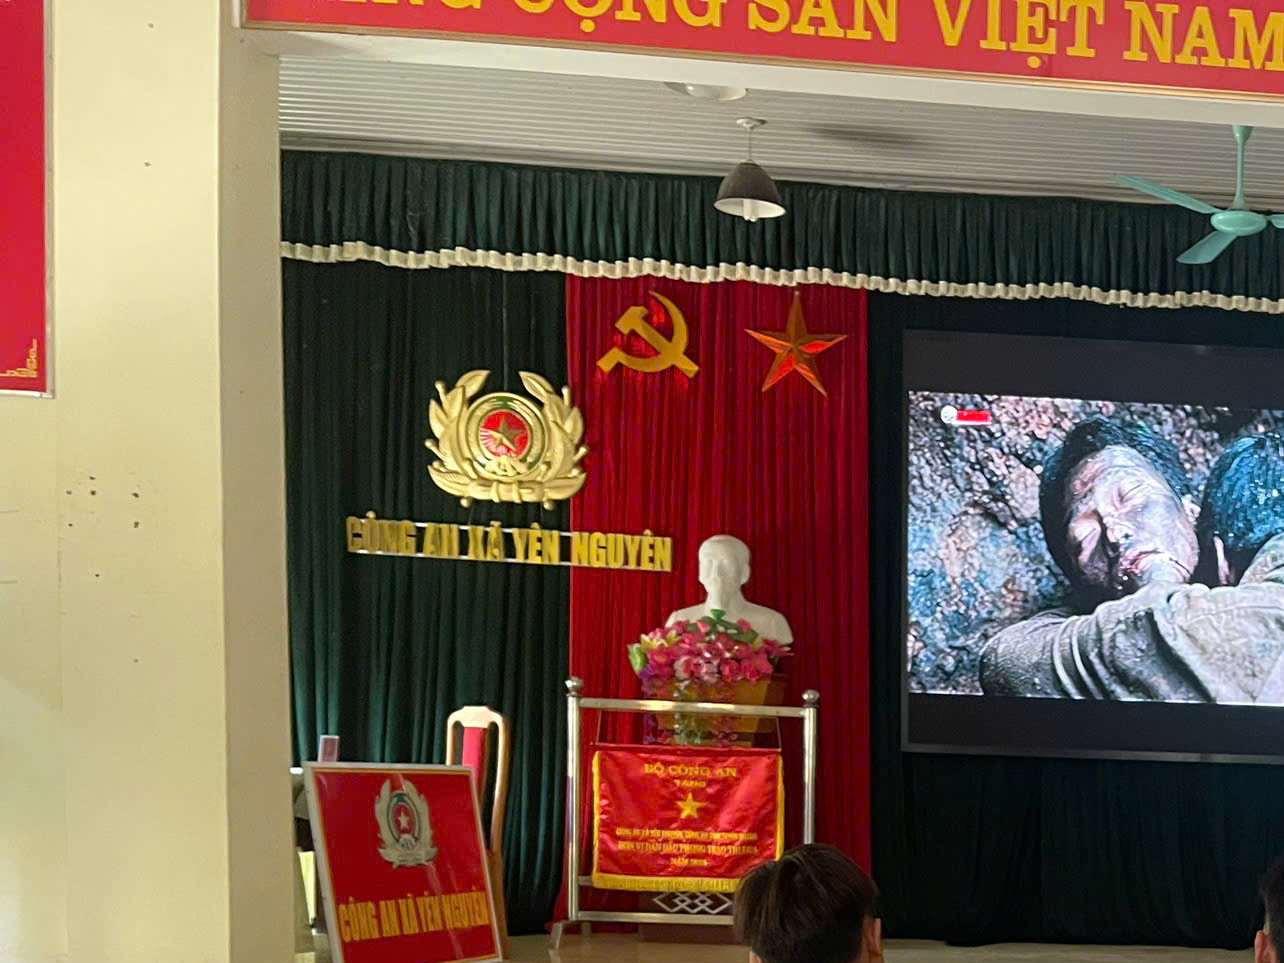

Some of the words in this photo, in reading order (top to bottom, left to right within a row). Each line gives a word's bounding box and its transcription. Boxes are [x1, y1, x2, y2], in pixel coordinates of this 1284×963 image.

[423, 523, 460, 559] AN
[467, 520, 503, 561] XÃ
[512, 522, 560, 565] YÊN
[571, 529, 672, 572] NGUYÊN
[715, 767, 738, 777] AN
